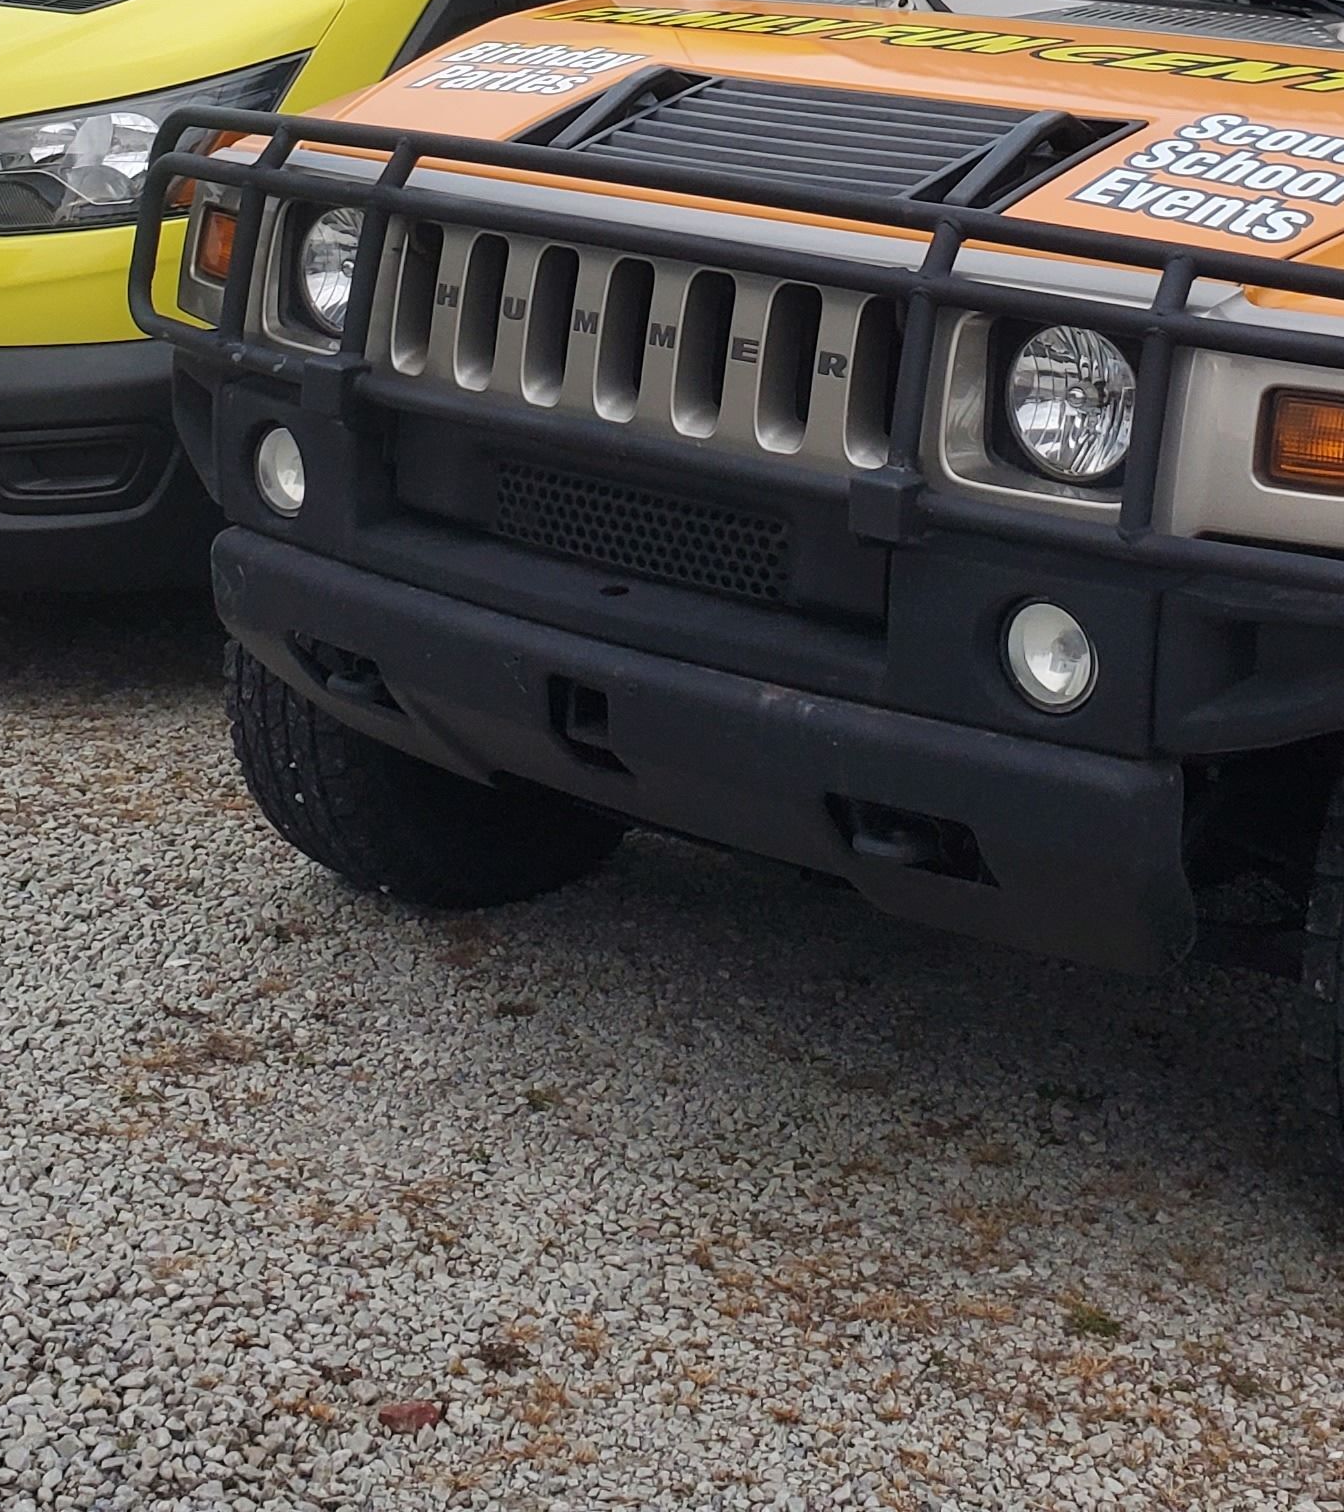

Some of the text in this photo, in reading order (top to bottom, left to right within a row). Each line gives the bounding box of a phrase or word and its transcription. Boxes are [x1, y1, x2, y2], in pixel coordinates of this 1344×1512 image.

[534, 7, 869, 37] FAMILY
[823, 23, 1073, 54] FUN
[408, 64, 592, 95] Parties
[439, 41, 652, 75] Birthday
[1067, 169, 1314, 243] Events
[436, 282, 849, 379] HUMMER
